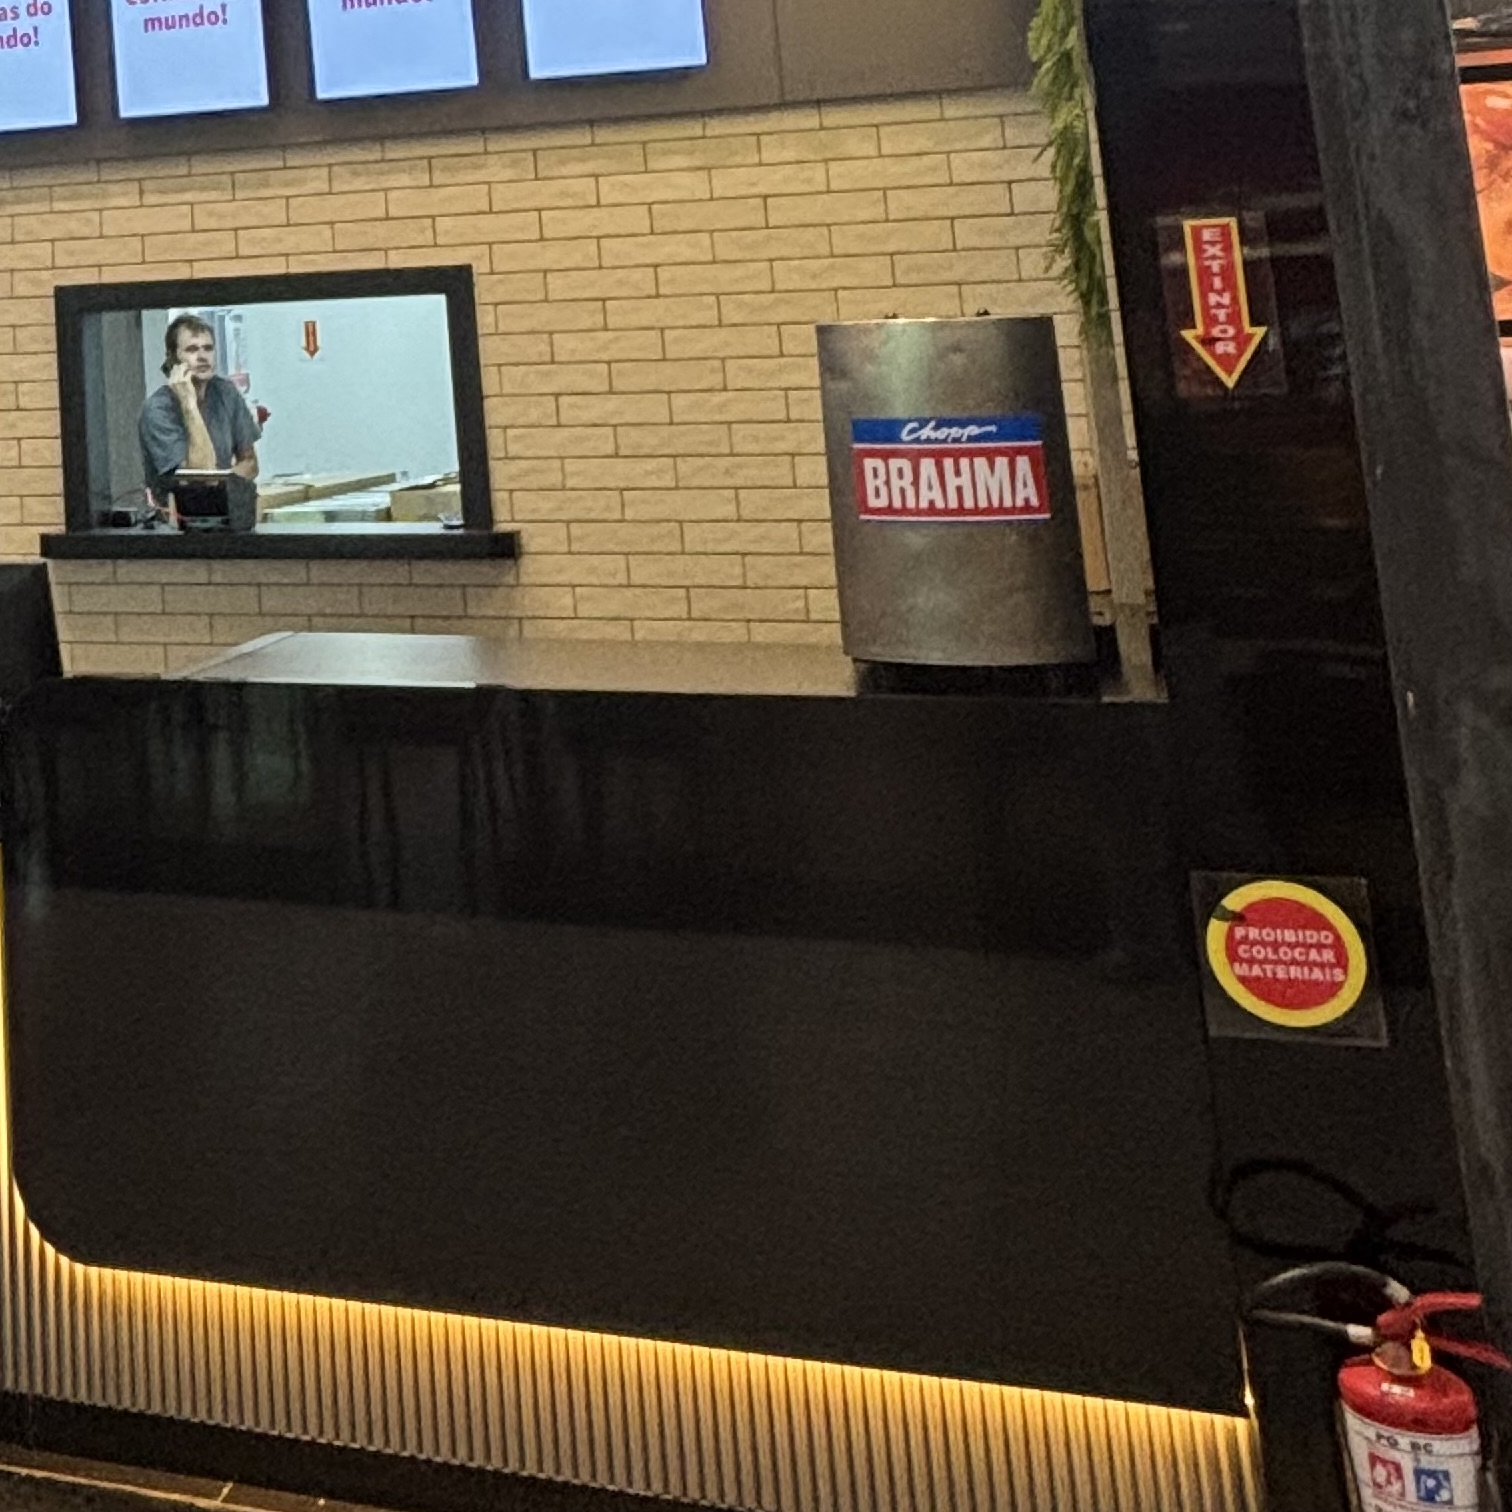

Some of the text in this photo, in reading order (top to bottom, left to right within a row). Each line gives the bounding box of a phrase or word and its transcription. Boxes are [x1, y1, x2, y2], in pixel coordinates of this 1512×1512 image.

[143, 4, 228, 33] mundo!
[1201, 228, 1236, 354] EXTINTOR
[901, 420, 997, 442] Chopp
[863, 456, 1039, 509] BRAHMA
[1235, 927, 1334, 944] PROIBIDO
[1238, 945, 1336, 963] COLOCAR
[1233, 963, 1346, 982] MATERIAIS
